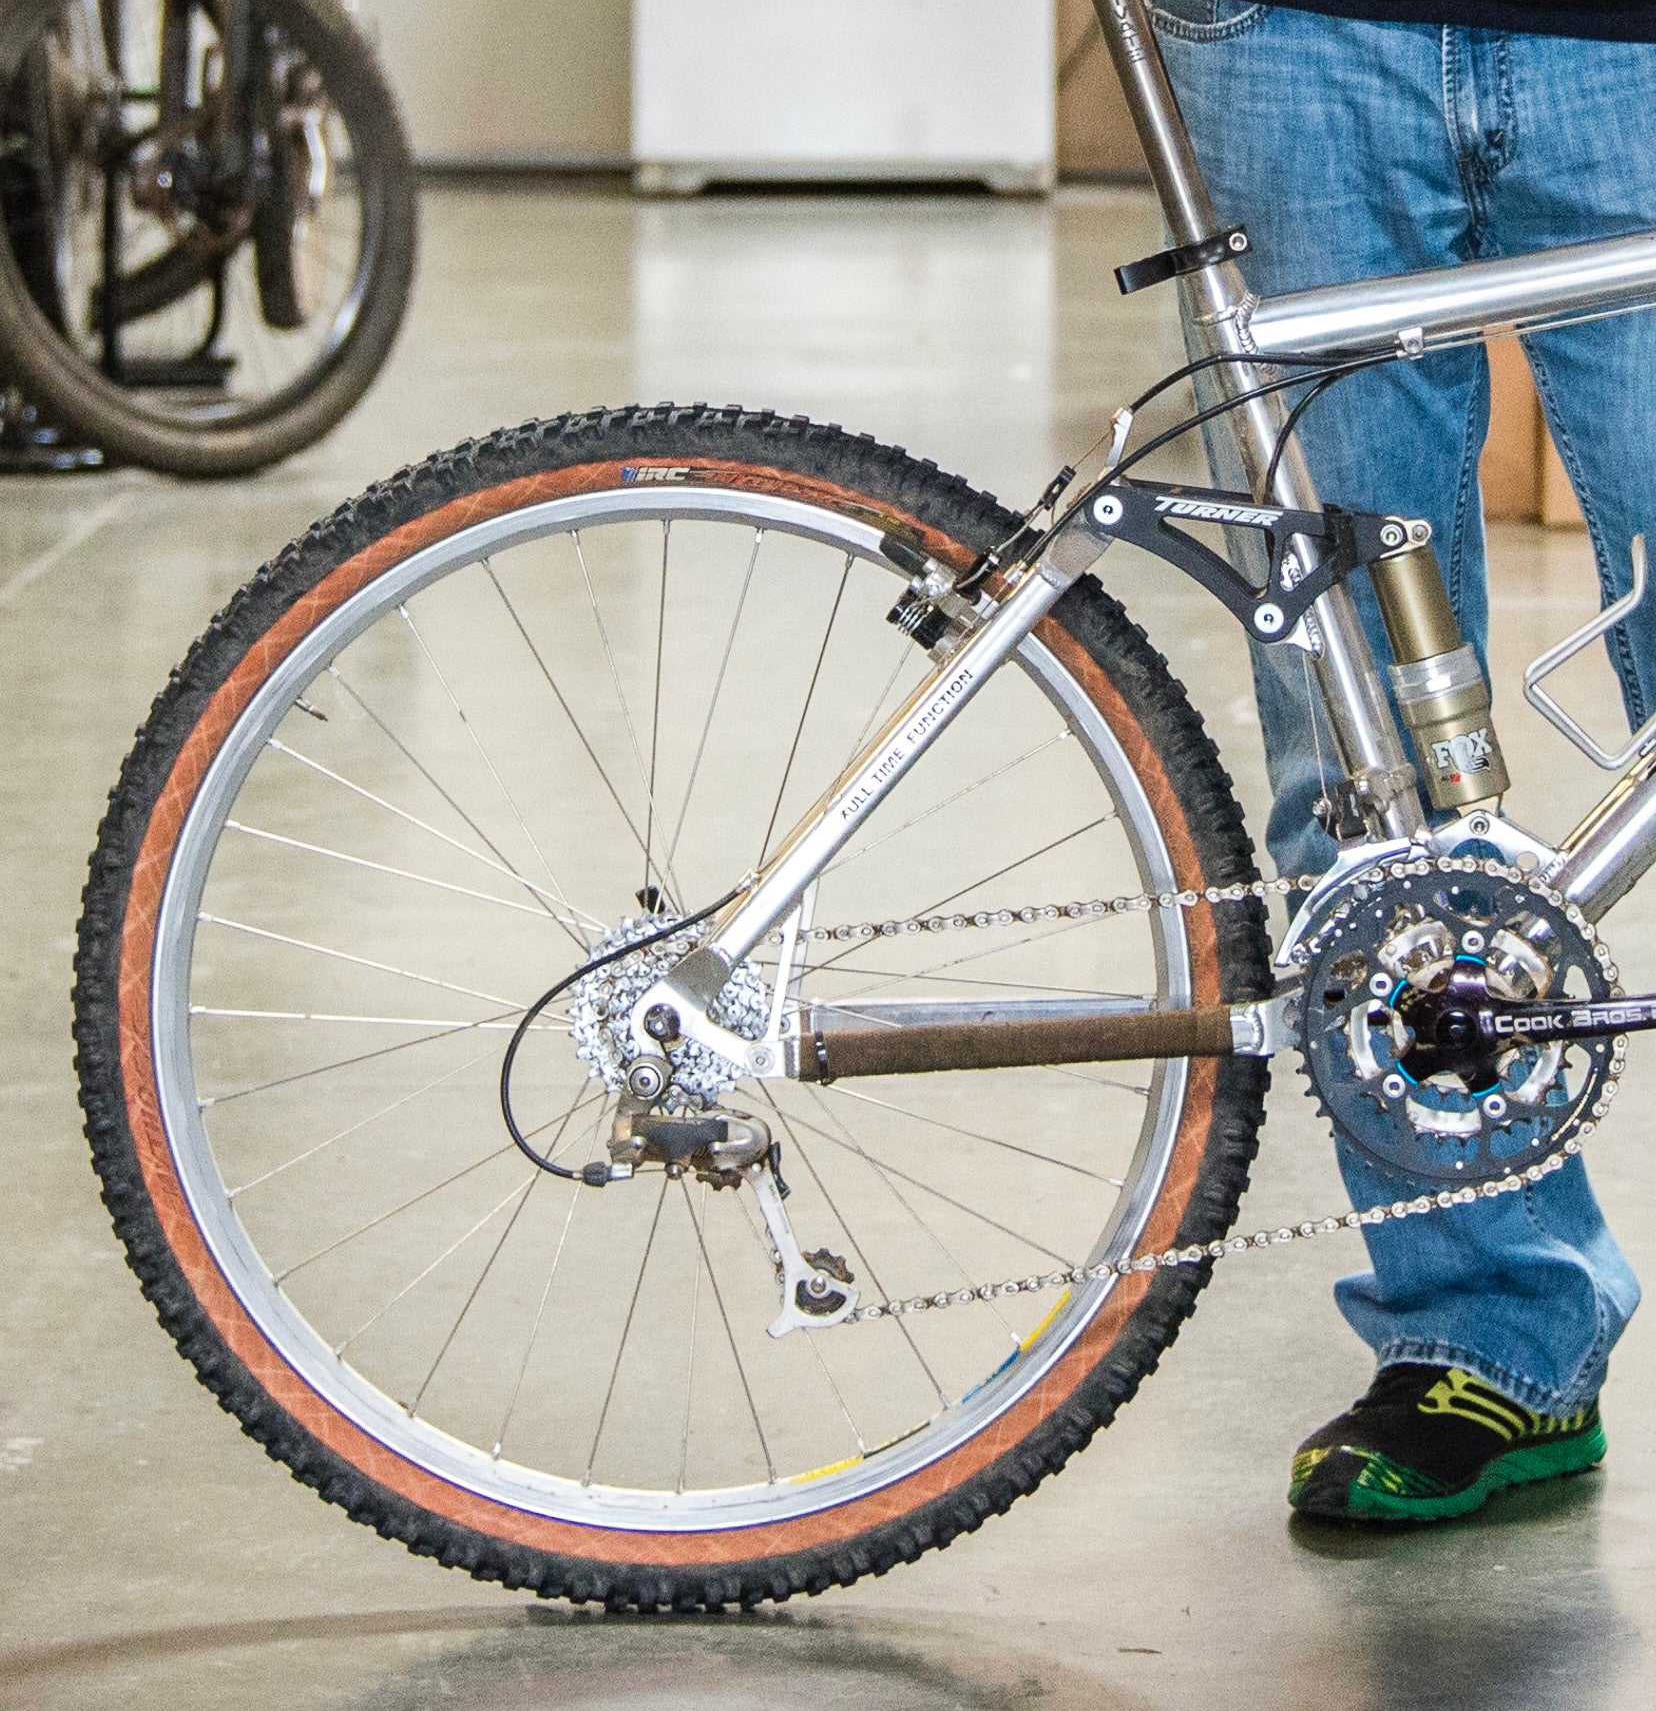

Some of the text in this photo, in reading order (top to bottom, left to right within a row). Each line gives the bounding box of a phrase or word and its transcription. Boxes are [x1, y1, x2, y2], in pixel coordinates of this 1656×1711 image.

[1155, 495, 1284, 528] TURNER
[870, 749, 905, 785] TIME
[906, 668, 975, 745] FUNCTION
[1431, 728, 1493, 774] FOX
